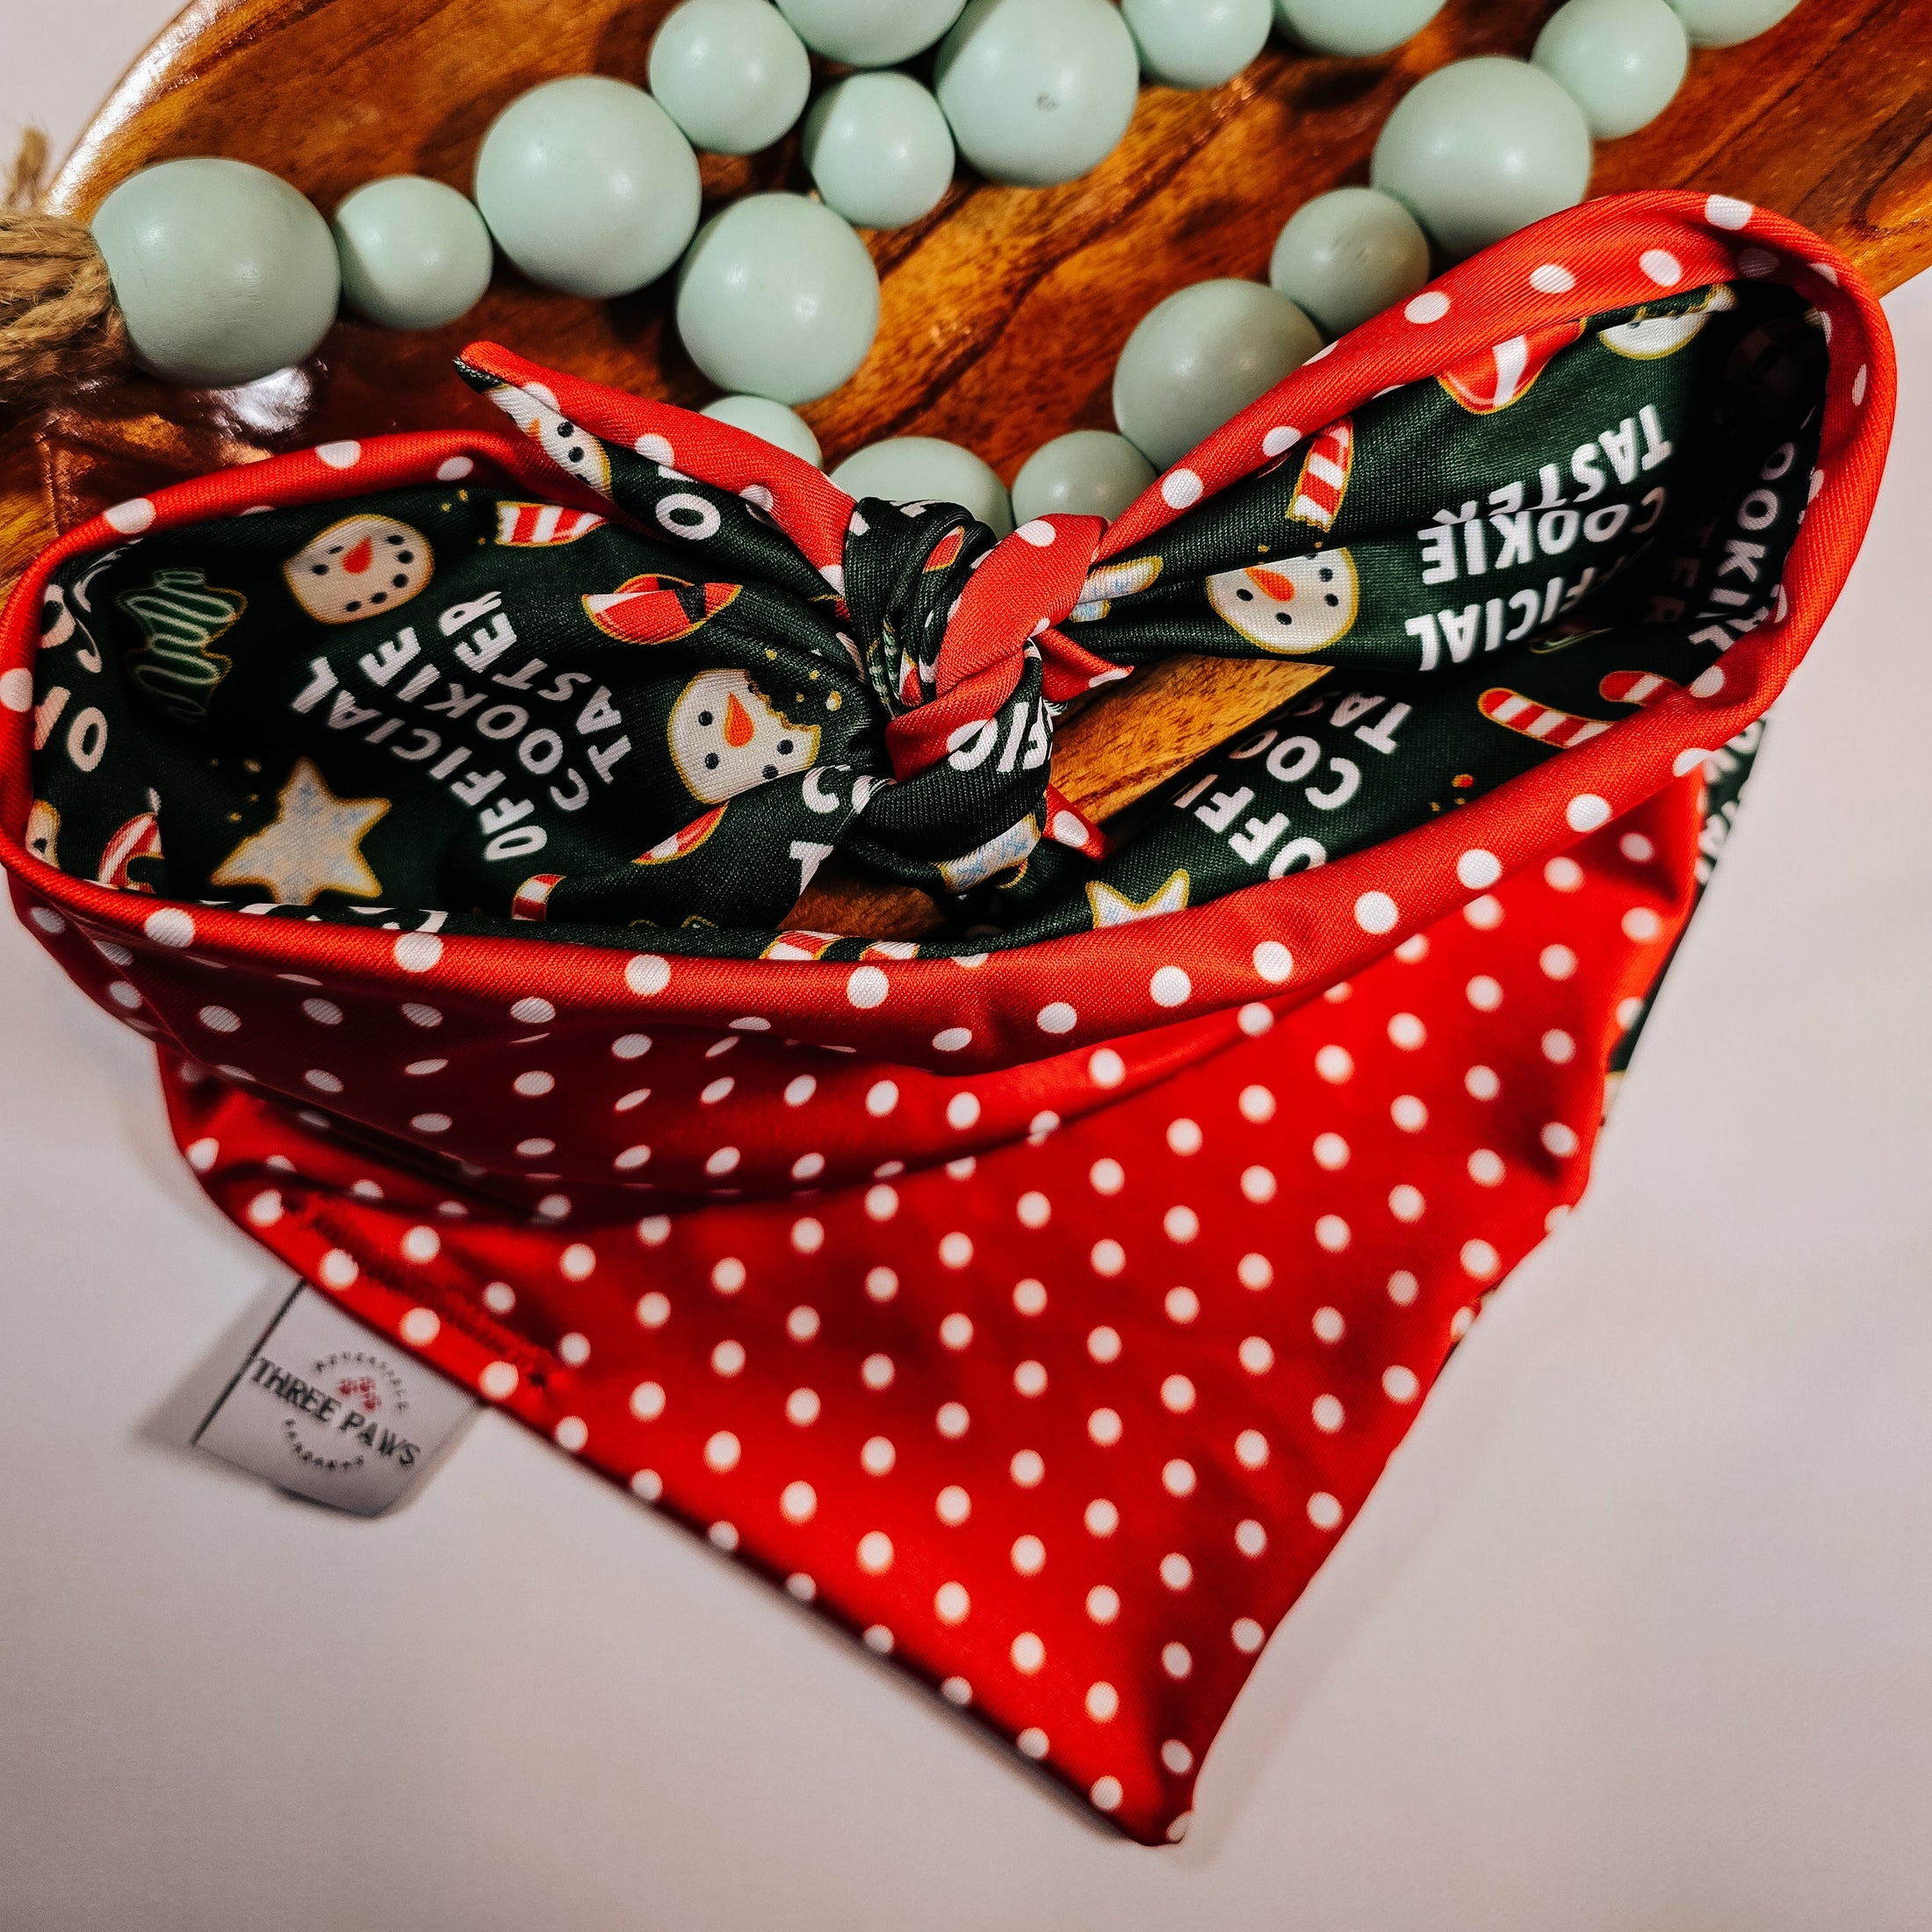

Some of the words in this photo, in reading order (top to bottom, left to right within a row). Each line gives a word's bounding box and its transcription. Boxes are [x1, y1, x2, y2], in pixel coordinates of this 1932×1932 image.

[1417, 486, 1667, 585] COOKIE
[292, 655, 547, 861] OFFICIAL
[358, 626, 590, 811] COOKIE
[439, 591, 632, 784] TASTER
[251, 1358, 342, 1423] THREE
[339, 1410, 422, 1467] PAWS
